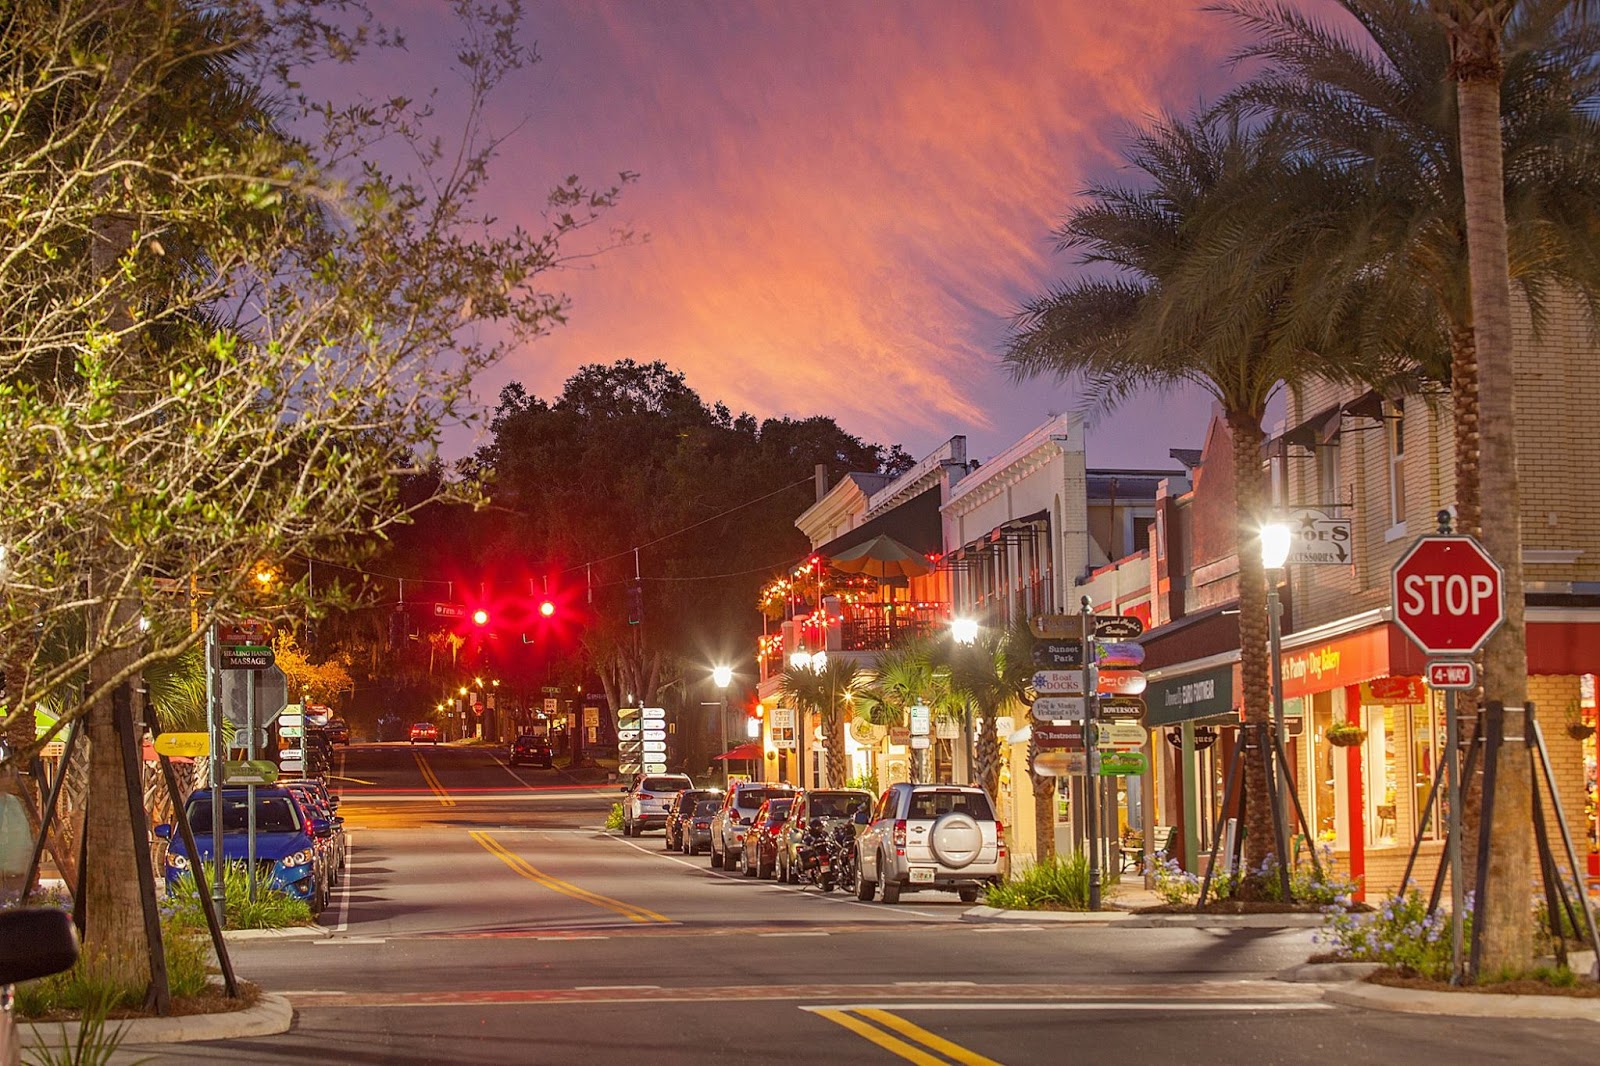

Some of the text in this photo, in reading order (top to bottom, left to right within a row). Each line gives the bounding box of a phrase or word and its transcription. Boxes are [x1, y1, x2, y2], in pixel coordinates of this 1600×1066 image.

[1403, 574, 1494, 616] STOP
[1048, 645, 1079, 653] Sunset
[230, 657, 267, 665] MASSAGE
[1054, 654, 1074, 662] Park
[1309, 652, 1322, 680] Dog
[1321, 645, 1340, 675] Bakery
[1052, 673, 1072, 681] Boat
[1434, 668, 1468, 682] 4-WAY
[1047, 681, 1079, 690] DOCKS
[1103, 706, 1140, 714] BOWERSOCK
[586, 717, 598, 725] 25
